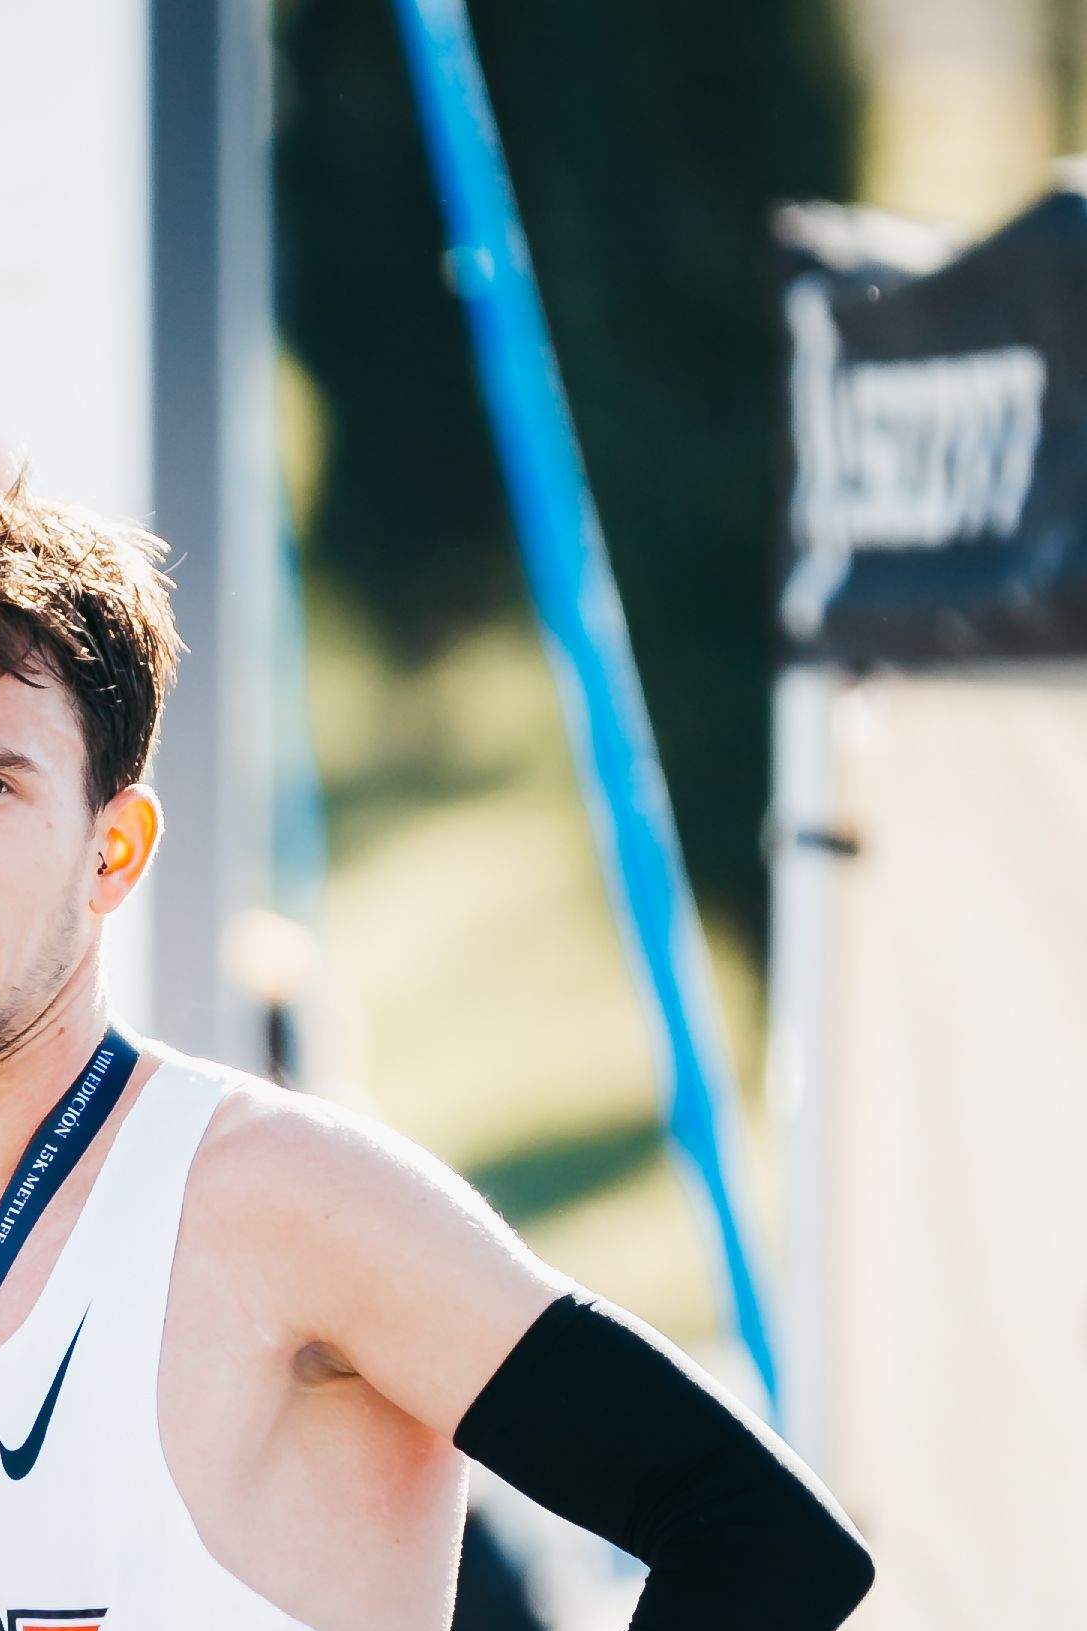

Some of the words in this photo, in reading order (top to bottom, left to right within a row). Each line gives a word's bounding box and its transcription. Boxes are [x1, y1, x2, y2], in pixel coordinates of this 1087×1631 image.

[91, 1048, 115, 1075] VIII
[53, 1073, 103, 1140] EDICIÓN
[32, 1143, 59, 1173] 15K
